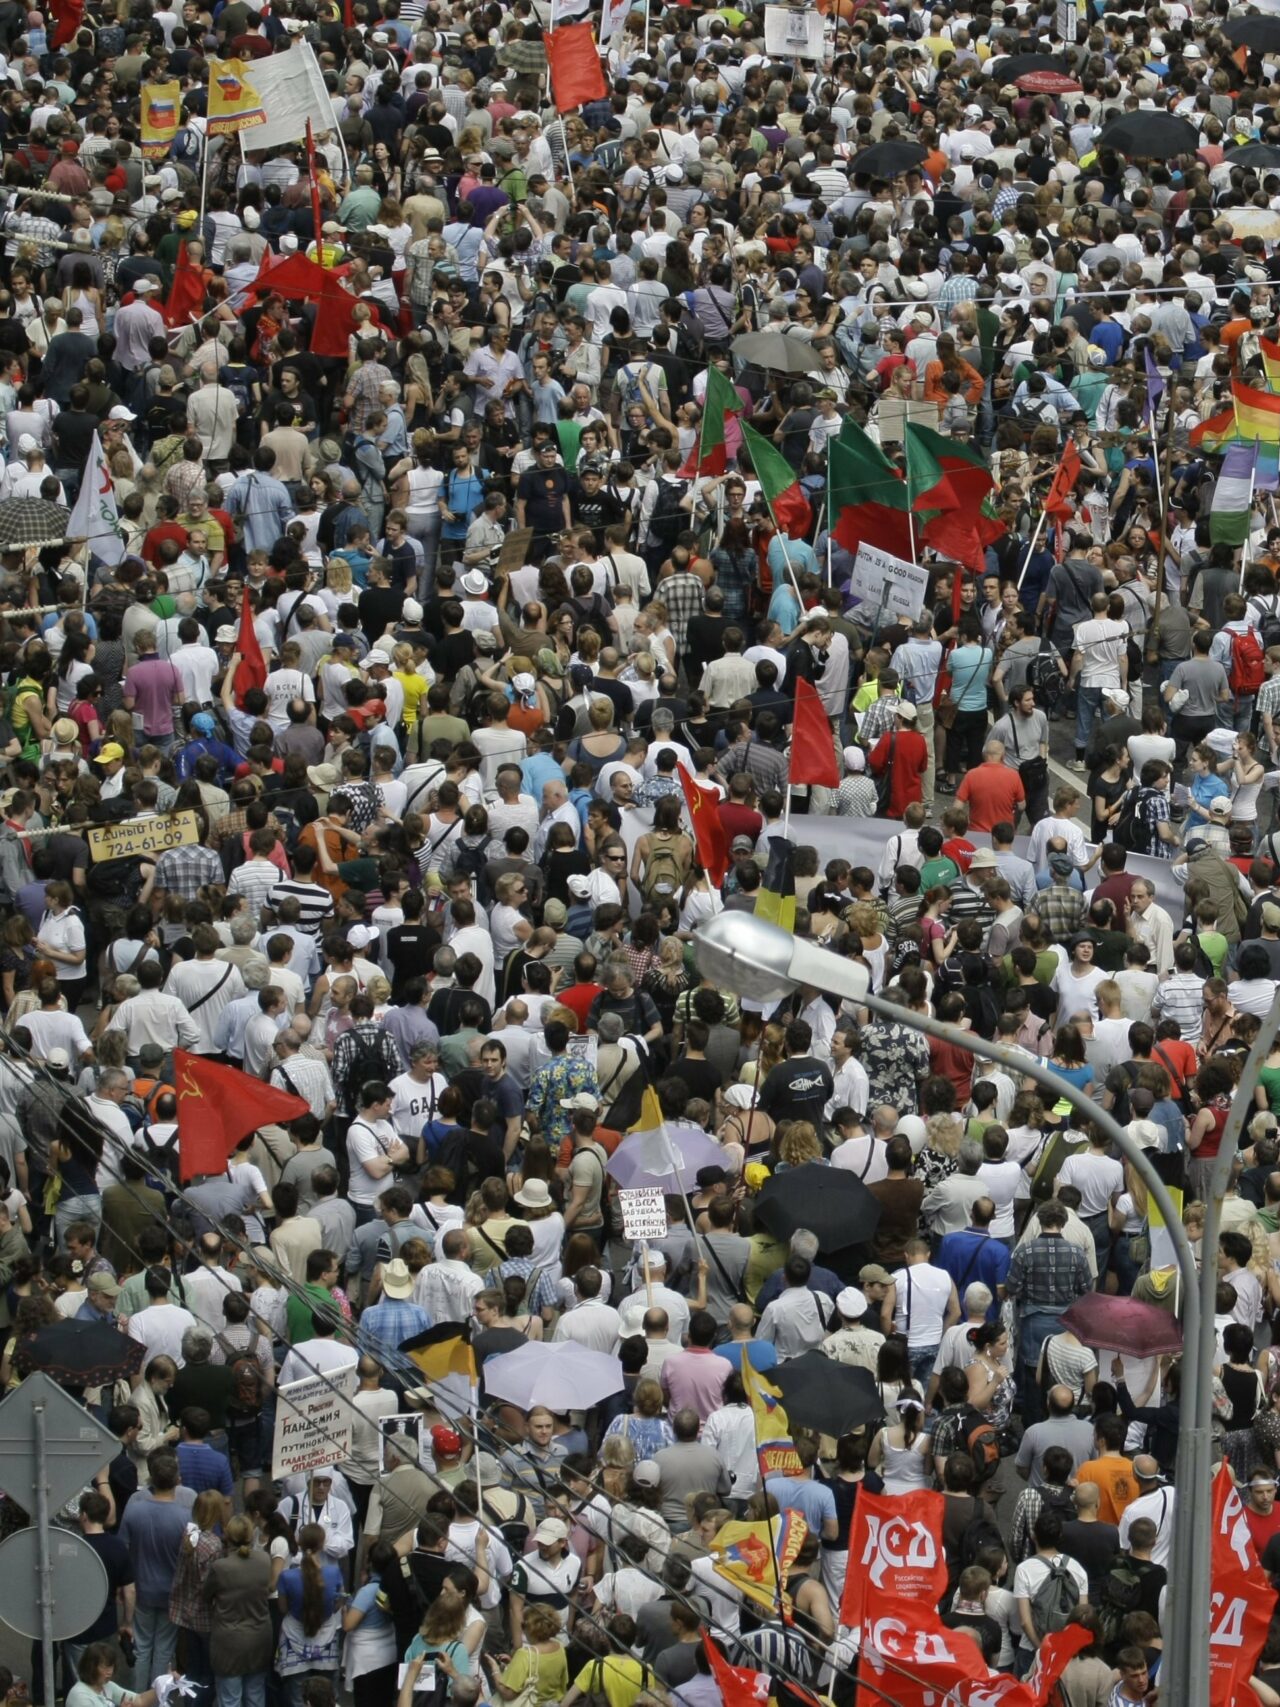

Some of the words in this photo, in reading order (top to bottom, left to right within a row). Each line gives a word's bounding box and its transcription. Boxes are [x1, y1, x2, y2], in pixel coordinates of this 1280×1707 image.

[888, 565, 907, 578] GOOD
[107, 831, 182, 857] 724-61-09
[860, 1514, 937, 1590] РСД
[512, 1571, 519, 1585] 3
